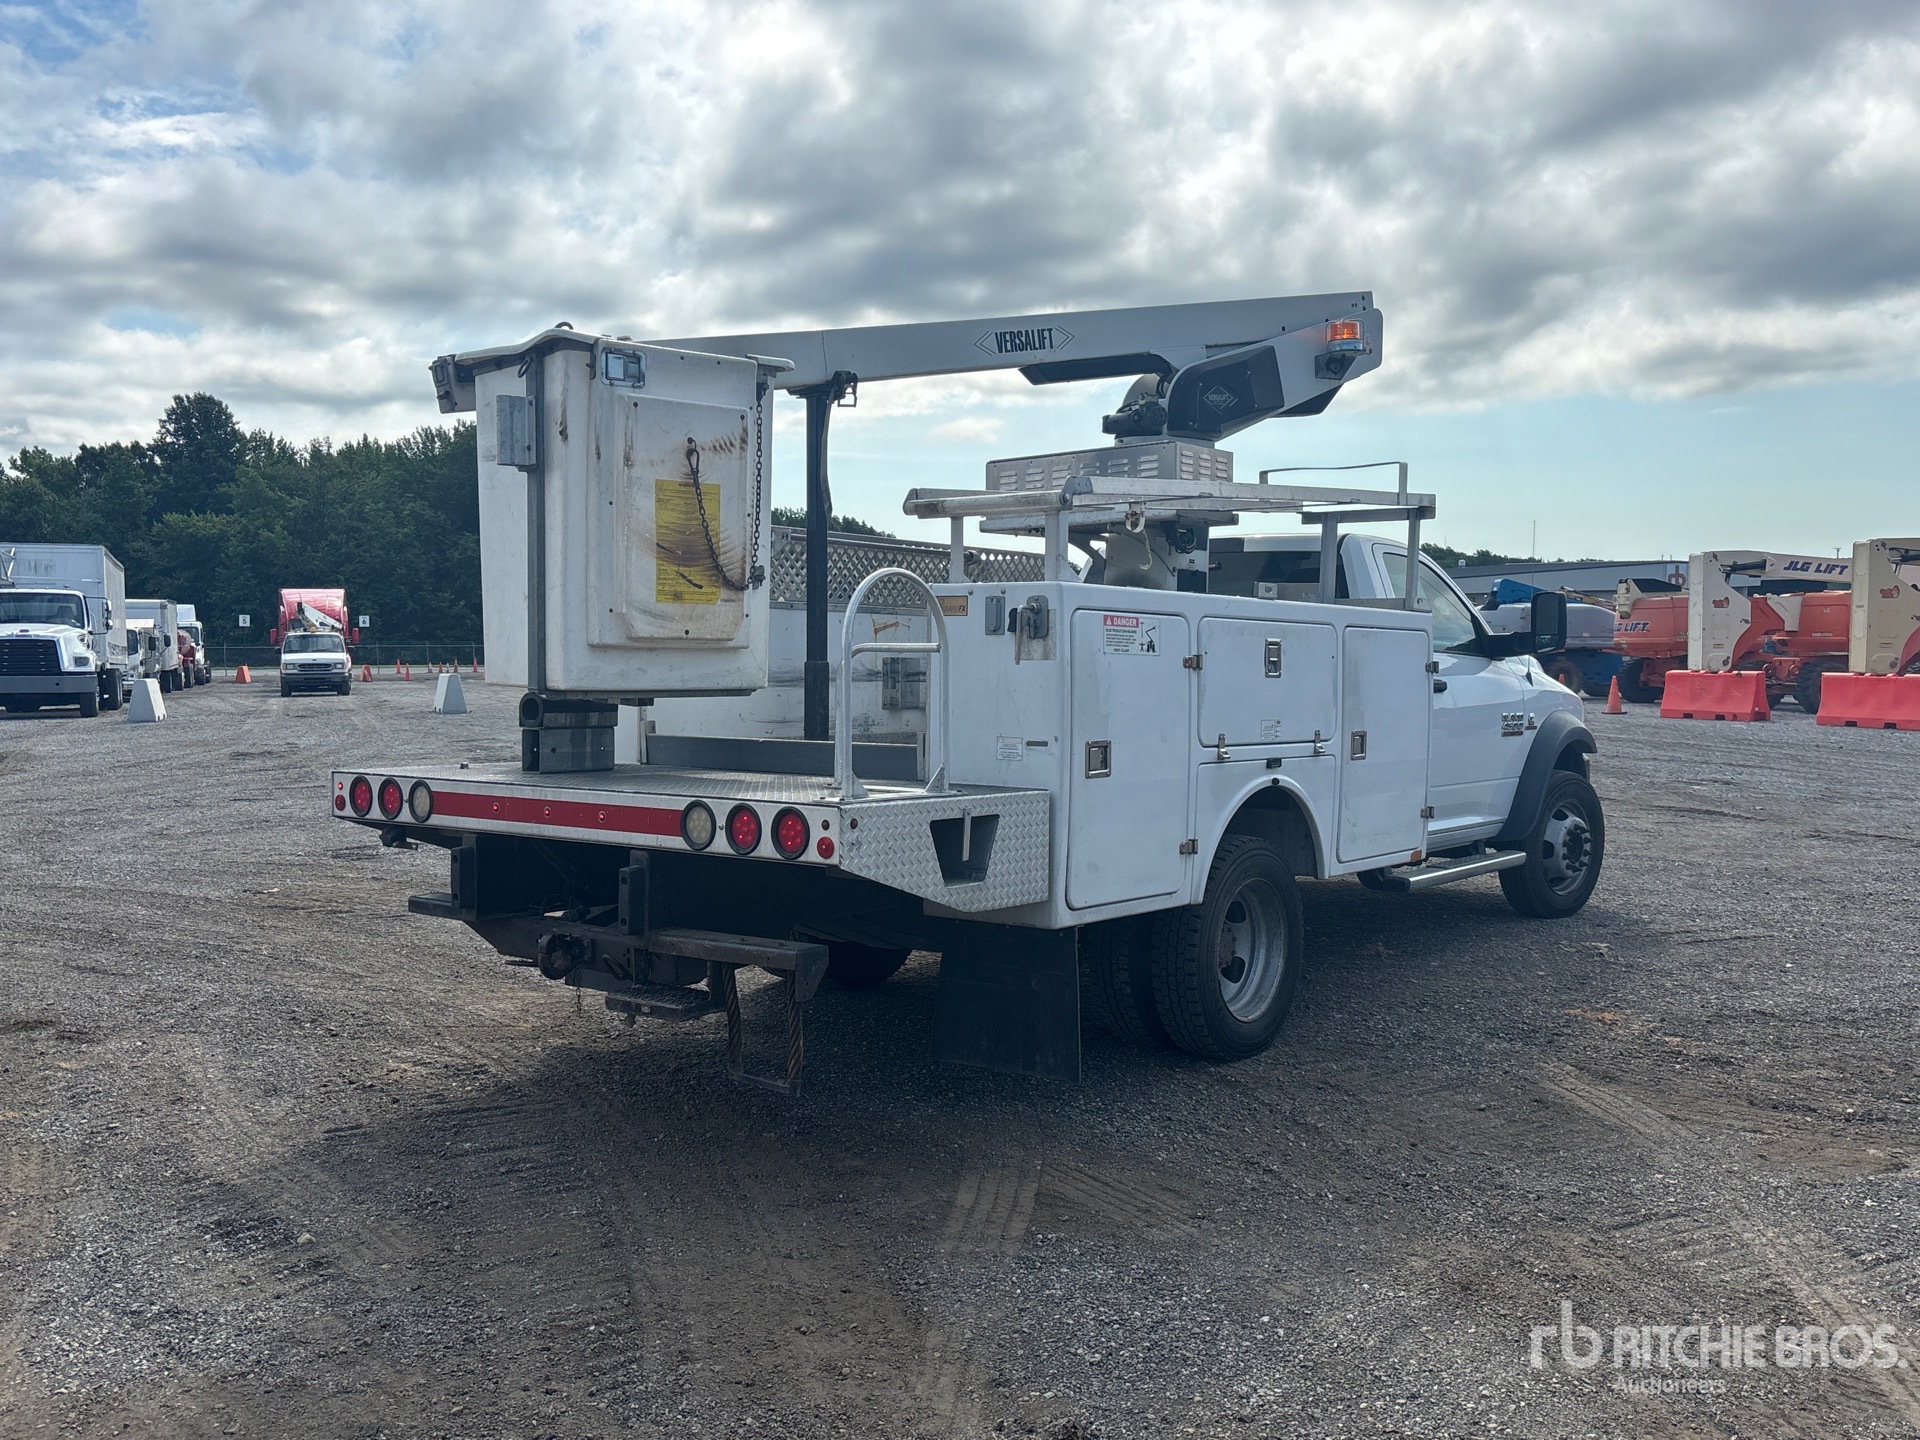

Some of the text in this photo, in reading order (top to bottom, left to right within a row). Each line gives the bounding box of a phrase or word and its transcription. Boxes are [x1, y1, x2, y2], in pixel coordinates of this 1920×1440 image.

[994, 328, 1054, 354] VERSALIFT
[1783, 560, 1849, 576] JLG LIFT
[1113, 616, 1137, 627] DANGER
[1623, 622, 1649, 632] LIFT
